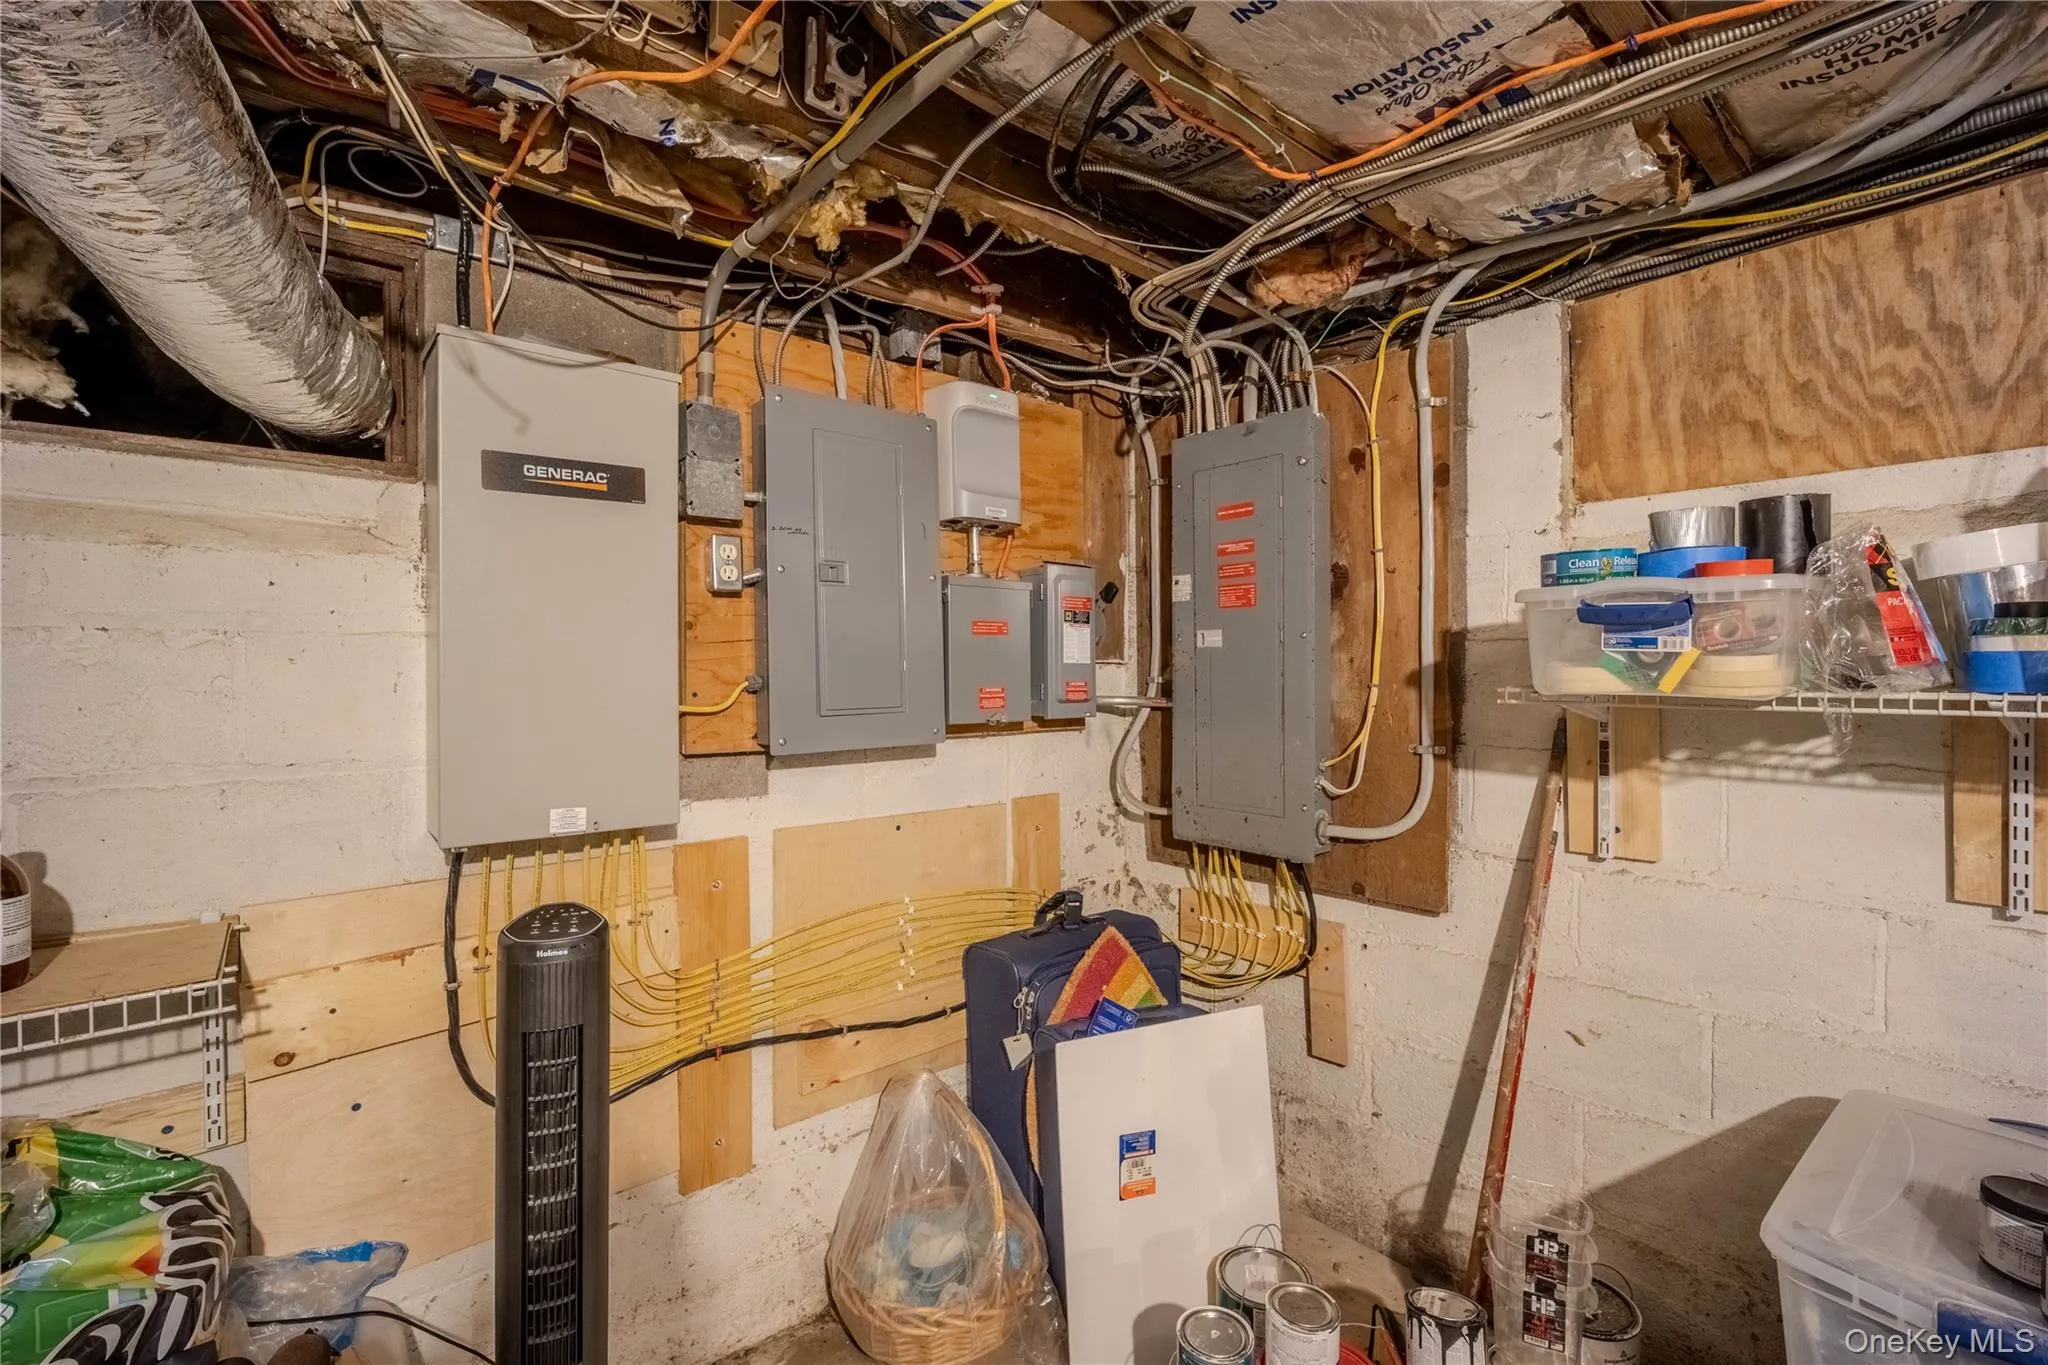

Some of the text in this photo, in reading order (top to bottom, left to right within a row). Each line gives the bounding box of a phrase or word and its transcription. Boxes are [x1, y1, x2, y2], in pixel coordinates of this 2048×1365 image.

[1823, 15, 1938, 70] HOME
[1332, 18, 1494, 105] INSULATION
[1432, 51, 1491, 84] Fiber
[1380, 54, 1463, 99] HOME
[523, 464, 608, 484] GENERAC
[1568, 558, 1600, 569] Clean
[1887, 596, 1906, 606] PAC
[536, 949, 569, 958] Holmes
